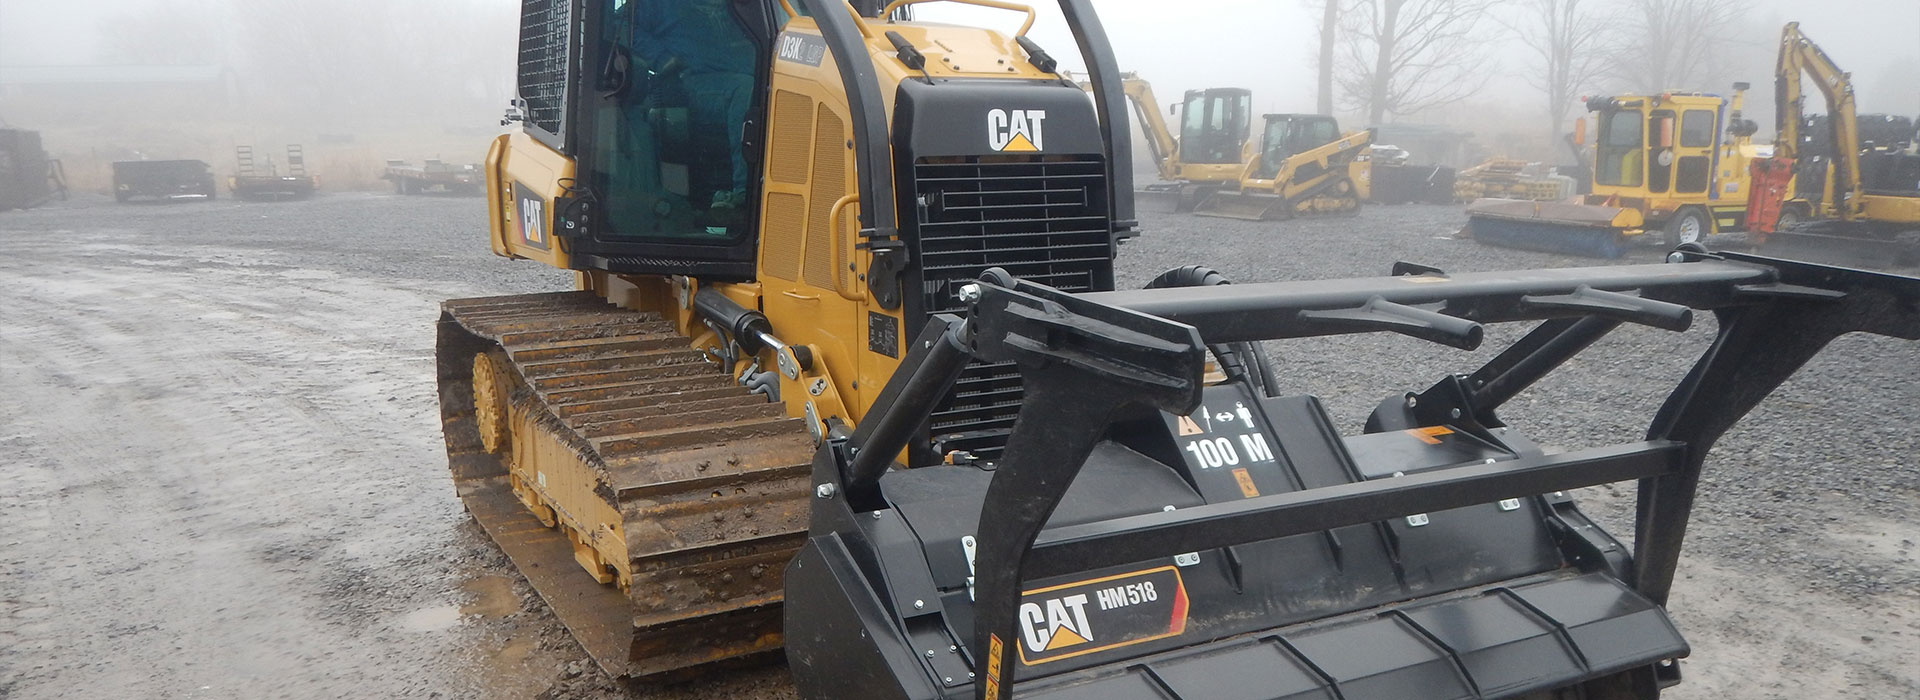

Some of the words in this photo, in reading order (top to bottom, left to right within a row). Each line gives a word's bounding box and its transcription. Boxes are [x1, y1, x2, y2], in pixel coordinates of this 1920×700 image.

[987, 108, 1046, 152] CAT
[523, 197, 542, 243] CAT
[1186, 437, 1240, 469] 100
[1239, 432, 1275, 462] M
[1019, 593, 1094, 652] CAT
[1096, 581, 1158, 611] HM518
